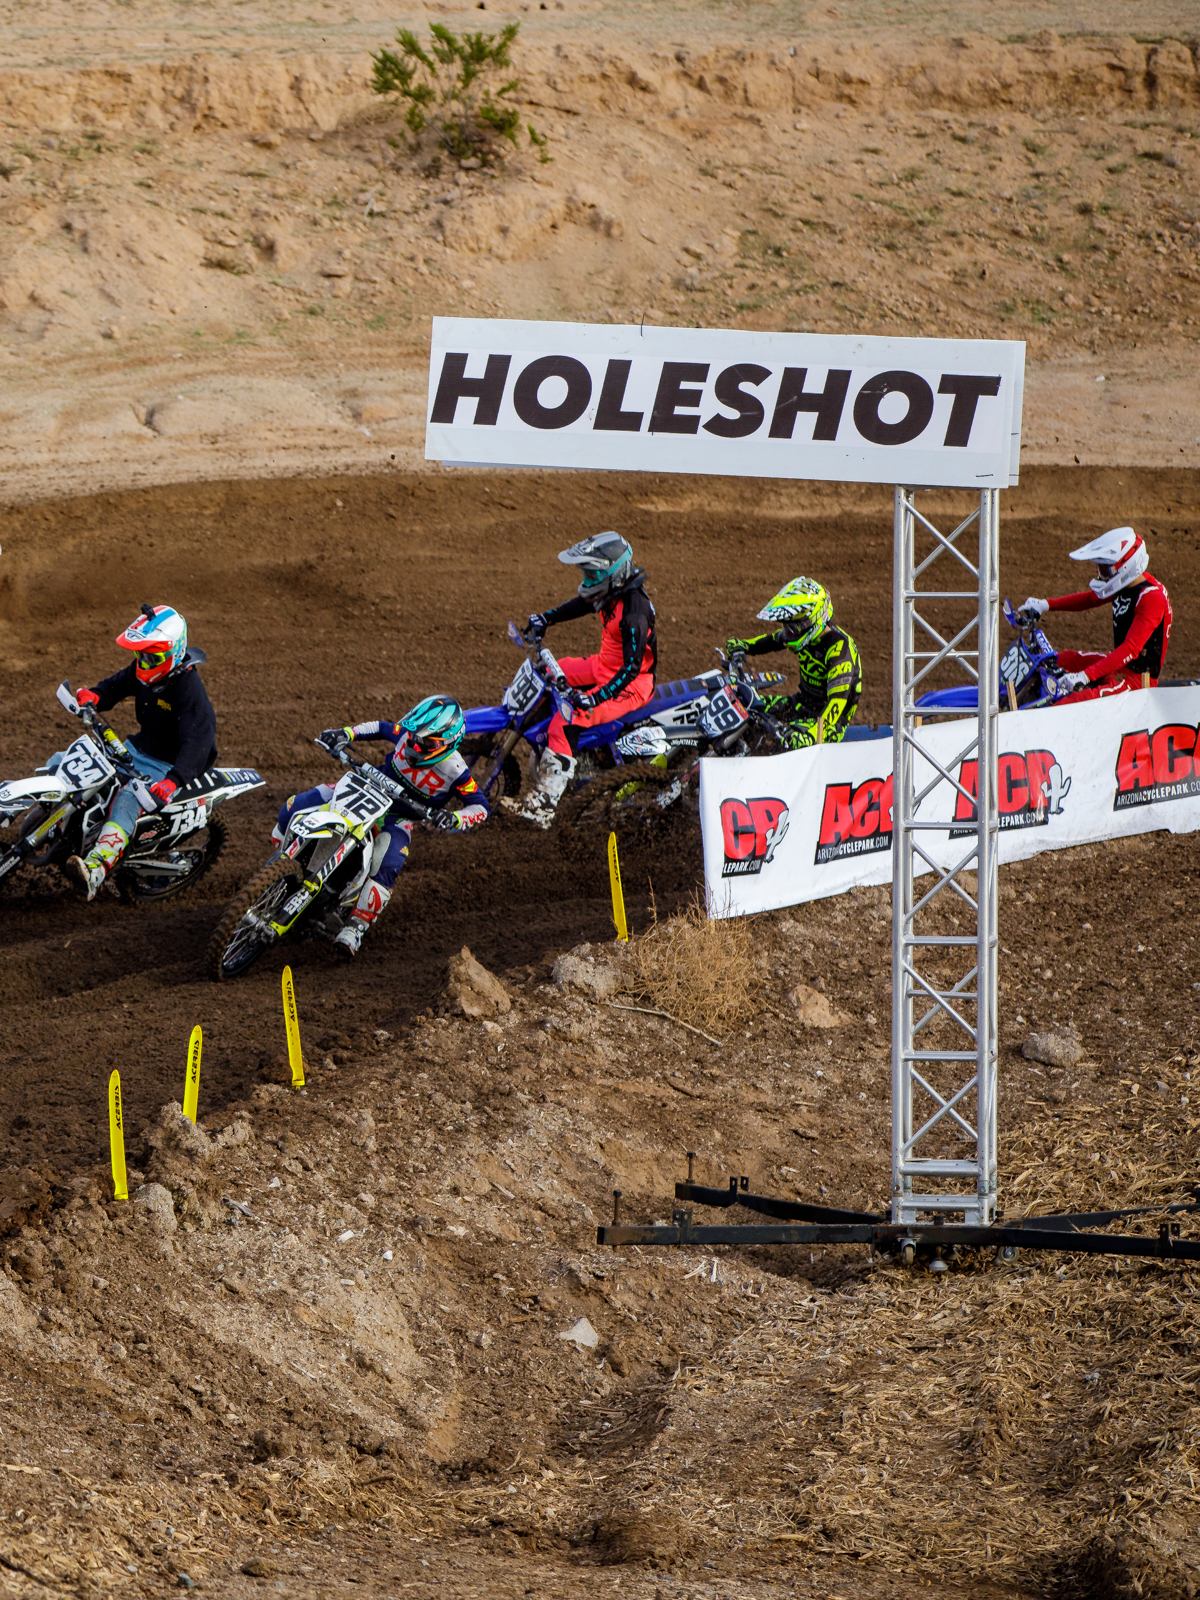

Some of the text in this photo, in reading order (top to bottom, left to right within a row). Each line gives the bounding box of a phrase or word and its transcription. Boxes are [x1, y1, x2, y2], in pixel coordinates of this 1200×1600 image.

[430, 352, 1002, 448] HOLESHOT
[708, 697, 741, 731] 99
[61, 744, 104, 788] 734
[1115, 722, 1200, 792] AC
[170, 804, 207, 835] 734
[335, 783, 382, 822] 712
[283, 888, 310, 915] EBC
[286, 981, 295, 1022] ACERBIS
[191, 1040, 200, 1083] ACERBIS
